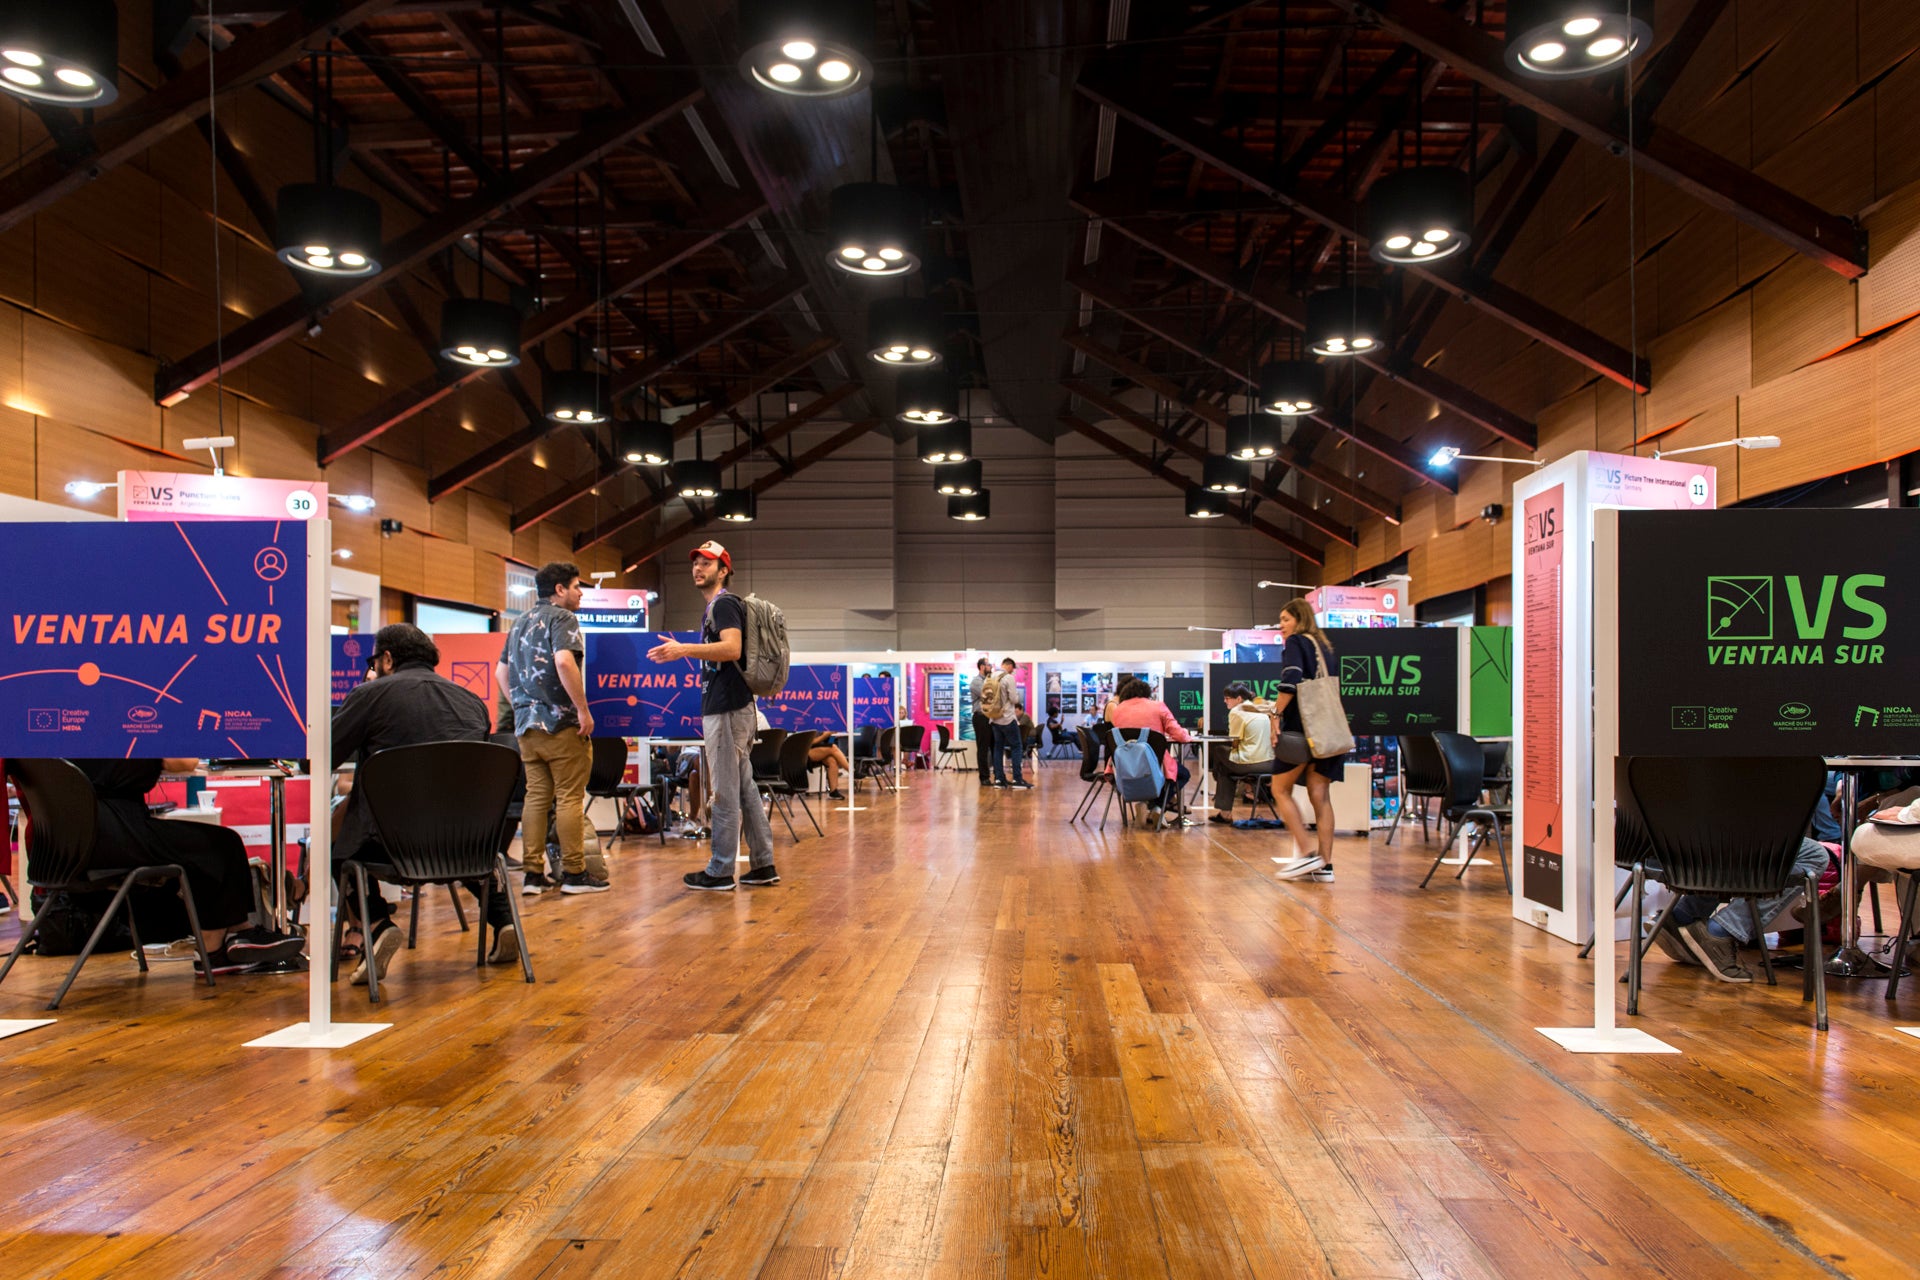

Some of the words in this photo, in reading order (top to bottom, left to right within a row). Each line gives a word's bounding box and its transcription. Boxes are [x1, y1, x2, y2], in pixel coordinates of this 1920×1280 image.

[1607, 469, 1621, 484] VS
[1624, 474, 1642, 482] Picture
[1643, 476, 1654, 484] Tree
[1655, 478, 1687, 488] International
[150, 487, 174, 501] VS
[1693, 484, 1704, 496] 11
[293, 499, 310, 510] 30
[1539, 508, 1555, 539] VS
[1528, 543, 1545, 556] VENTANA
[1546, 540, 1555, 550] SUR
[1784, 573, 1887, 640] VS
[595, 614, 638, 623] REPUBLIC
[13, 614, 189, 645] VENTANA
[204, 614, 282, 645] SUR
[1707, 645, 1824, 665] VENTANA
[1834, 644, 1885, 665] SUR
[1375, 655, 1422, 685] VS
[597, 673, 677, 688] VENTANA
[816, 690, 839, 700] SUR
[1341, 686, 1394, 696] VENTANA
[1397, 686, 1421, 696] SUR
[871, 697, 889, 705] SUR
[62, 709, 90, 717] Creative
[1708, 706, 1738, 714] Creative
[1708, 714, 1734, 722] Europe
